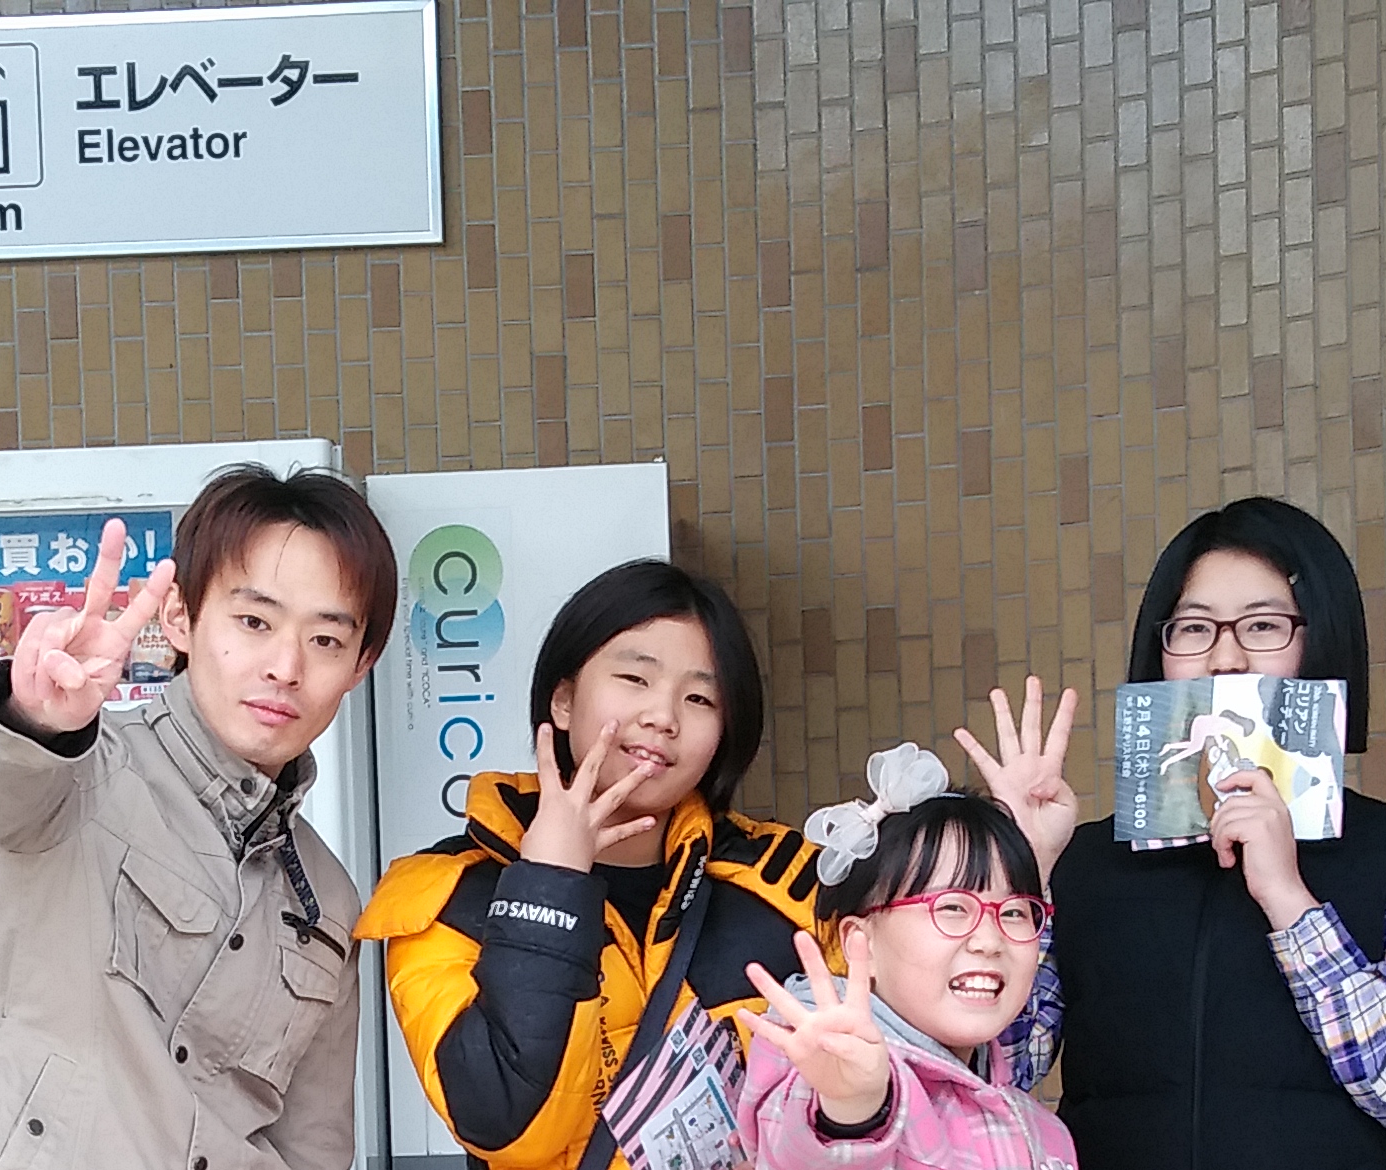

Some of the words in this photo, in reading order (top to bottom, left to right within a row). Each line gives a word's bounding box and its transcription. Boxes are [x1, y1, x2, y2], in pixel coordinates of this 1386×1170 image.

[75, 54, 360, 112] エレベーター
[77, 126, 248, 165] Elevator
[432, 551, 495, 818] curico
[1294, 682, 1311, 734] コリアン
[1277, 678, 1295, 746] パーティー
[1133, 794, 1147, 829] 6:00
[508, 902, 579, 931] ALWAYS
